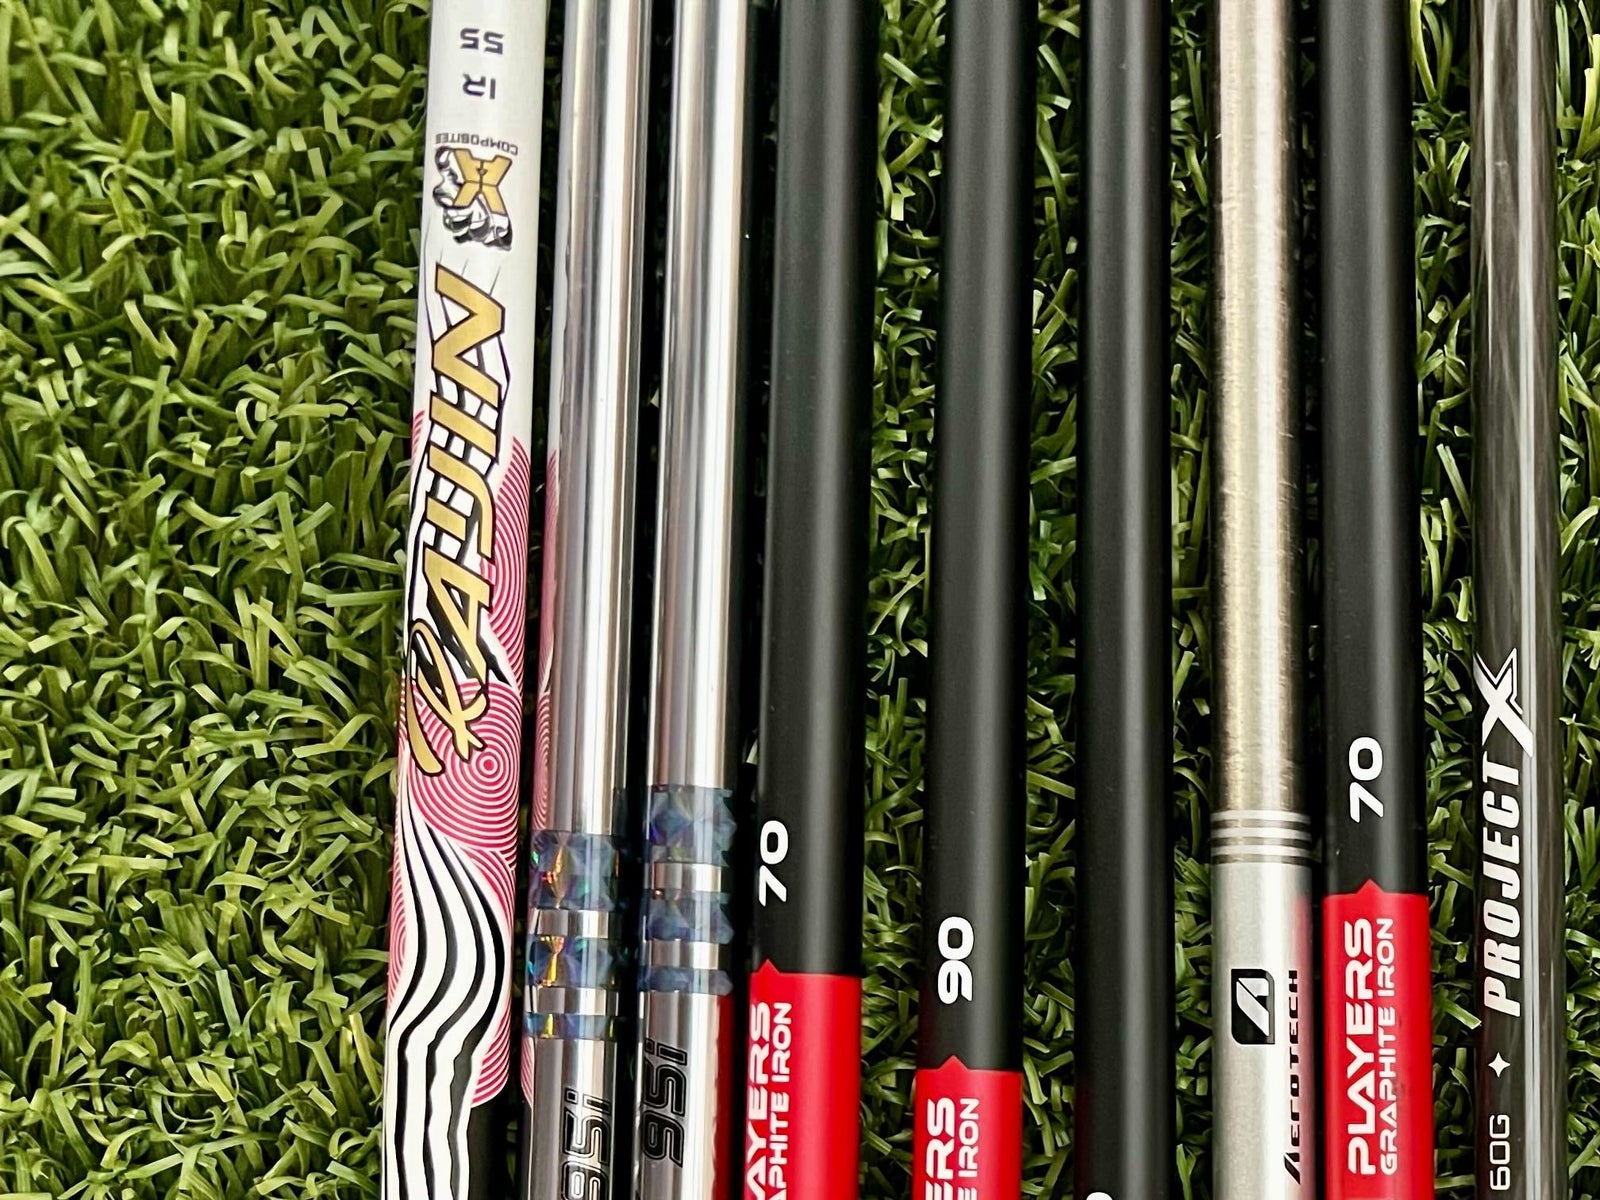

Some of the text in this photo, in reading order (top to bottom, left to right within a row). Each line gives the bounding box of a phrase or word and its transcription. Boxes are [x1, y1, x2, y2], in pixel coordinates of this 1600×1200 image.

[460, 27, 504, 55] 55
[435, 132, 518, 155] COMPOSITES
[403, 262, 505, 775] RAIJIN
[1348, 736, 1384, 823] 70
[759, 820, 789, 907] 70
[1473, 648, 1534, 1018] PROJECT X
[938, 916, 974, 1005] 90
[772, 1003, 792, 1083] IRON
[1344, 917, 1377, 1176] PLAYERS
[1376, 917, 1398, 1176] GRAPHITE IRON
[641, 1037, 688, 1167] 95i
[958, 1098, 980, 1178] IRON
[1489, 1113, 1511, 1191] 60G
